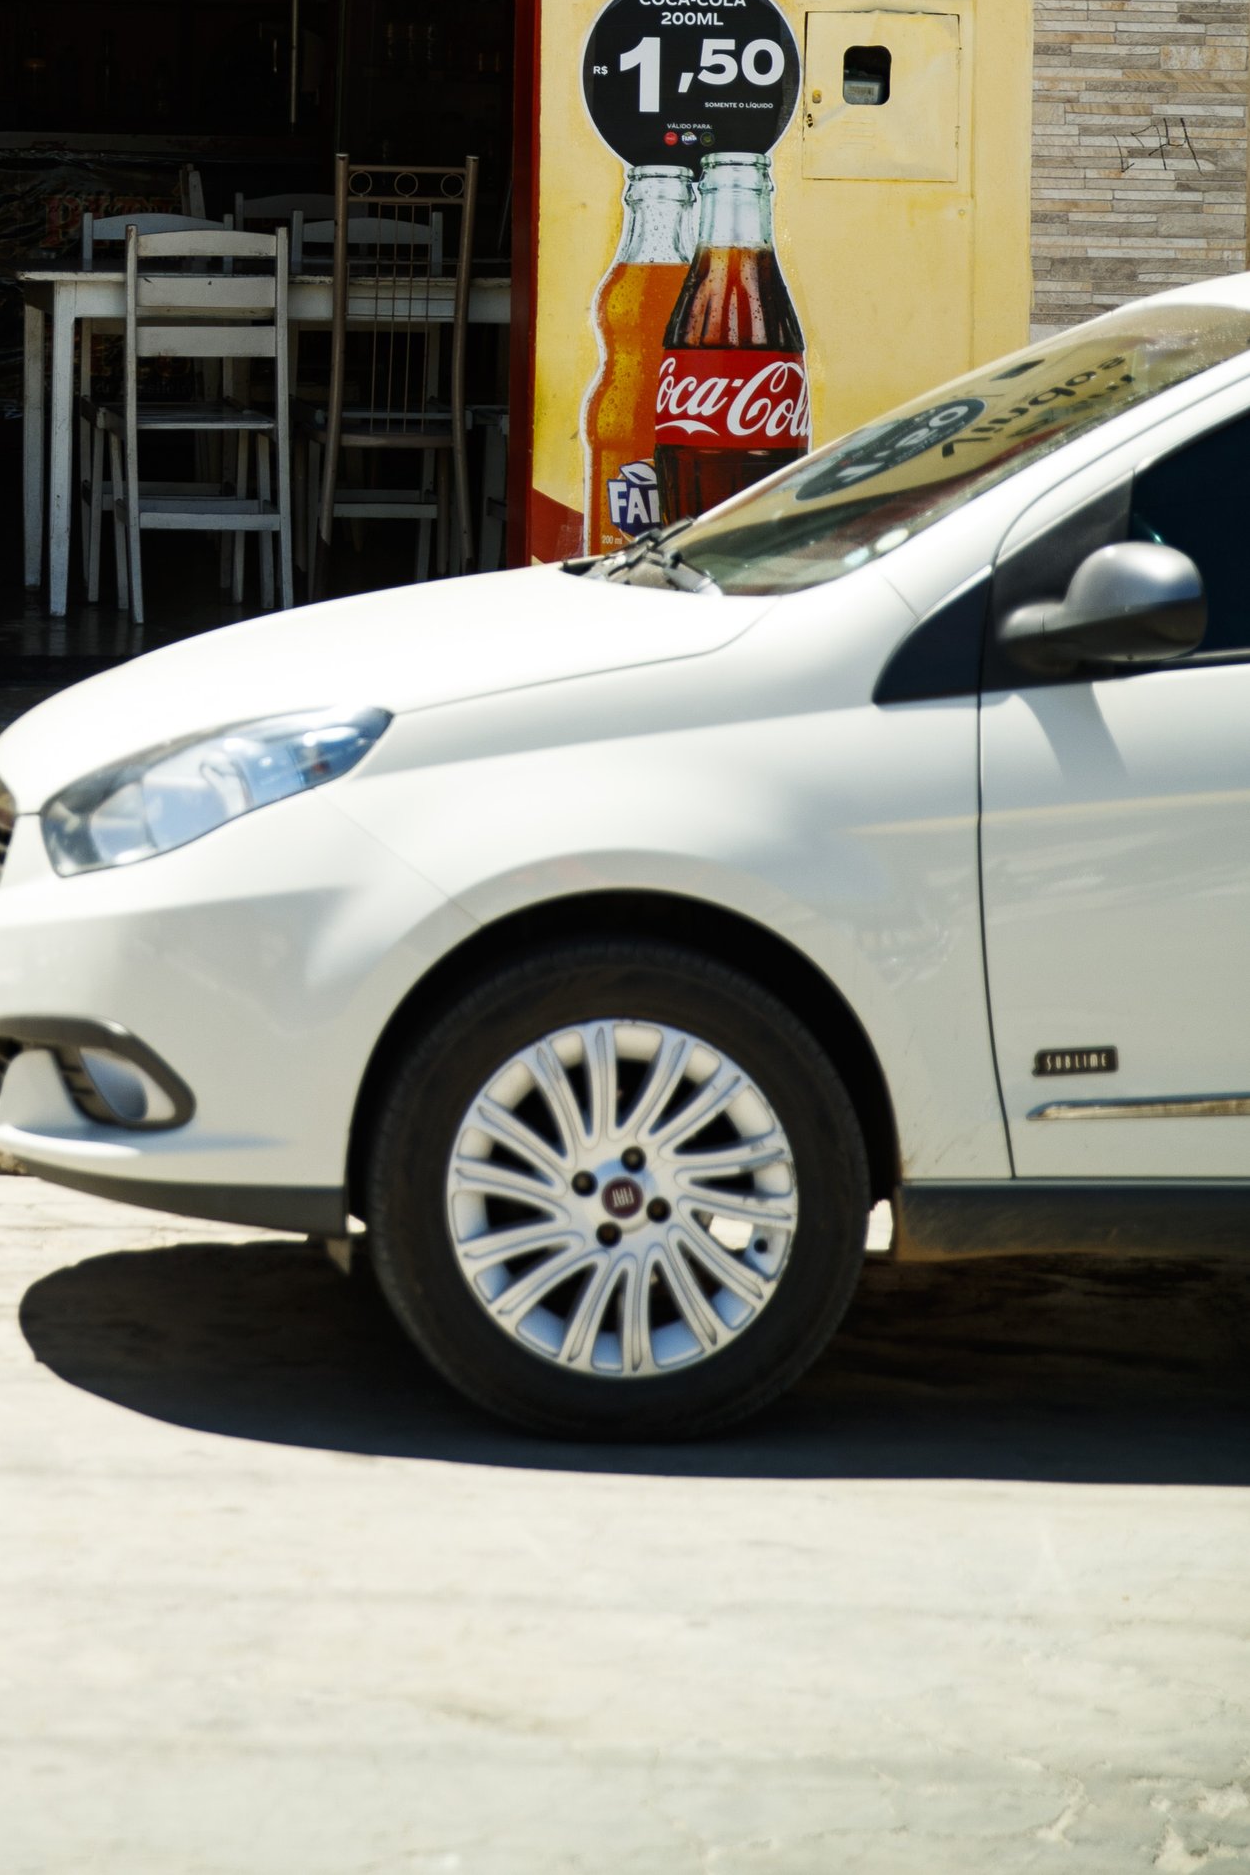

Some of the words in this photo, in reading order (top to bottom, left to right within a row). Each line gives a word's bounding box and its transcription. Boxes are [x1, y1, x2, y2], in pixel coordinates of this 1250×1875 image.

[660, 11, 724, 26] 200ML
[593, 65, 608, 76] R$
[704, 101, 738, 109] SOMENTE
[745, 101, 774, 110] LÍQUIDO
[1046, 1052, 1108, 1071] SUBLIME
